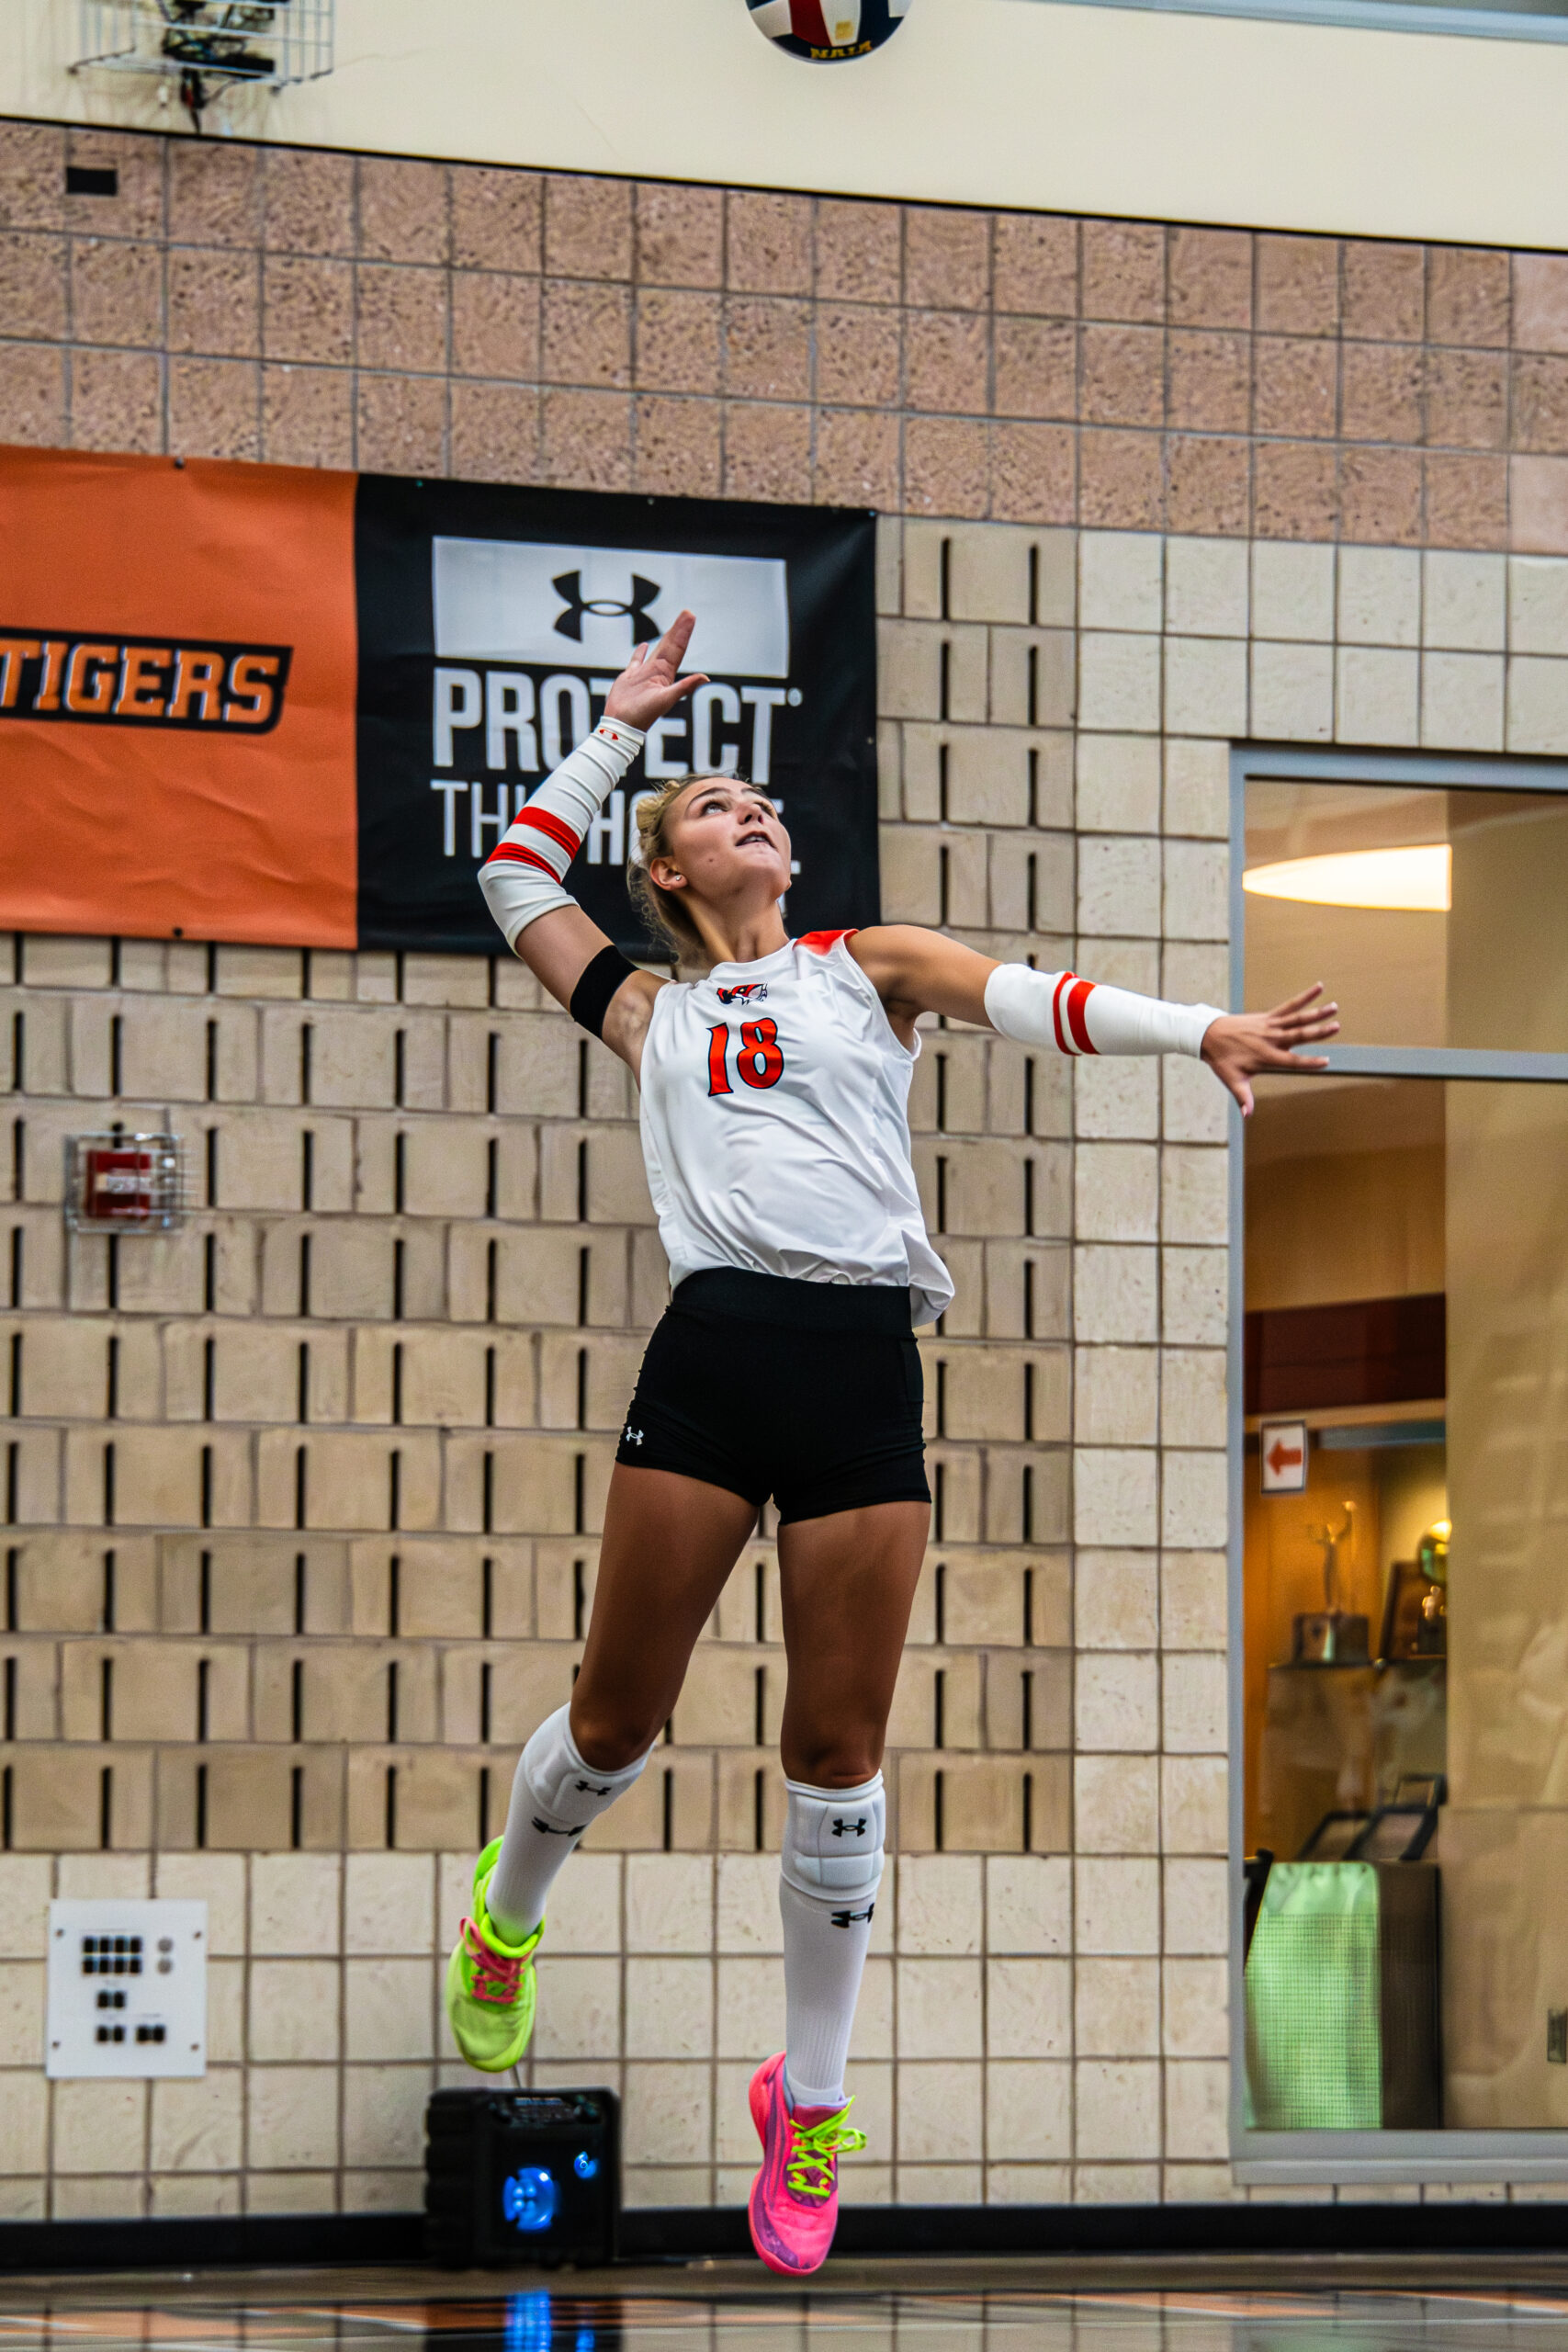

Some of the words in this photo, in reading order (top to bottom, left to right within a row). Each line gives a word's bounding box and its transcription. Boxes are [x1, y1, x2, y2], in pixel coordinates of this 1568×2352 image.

[0, 639, 280, 724] TIGERS
[433, 667, 787, 786] PROECT
[430, 779, 526, 858] TH
[706, 1017, 784, 1097] 18
